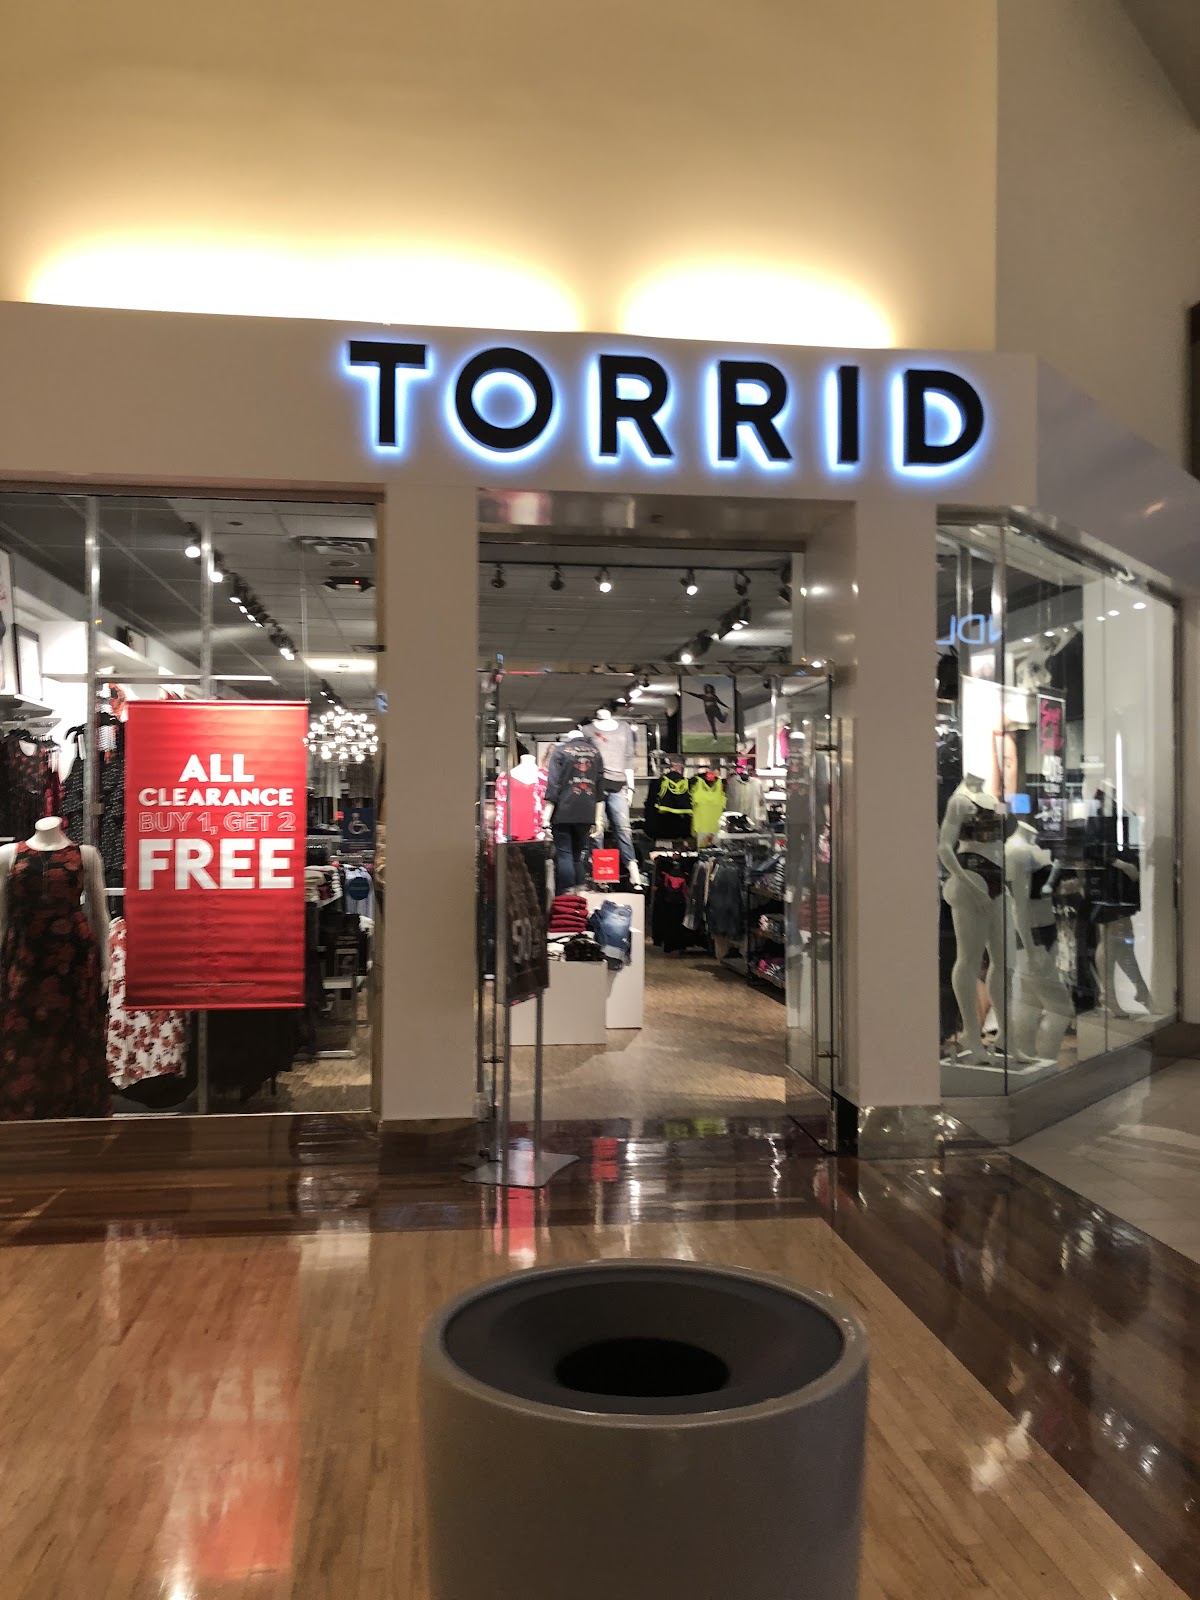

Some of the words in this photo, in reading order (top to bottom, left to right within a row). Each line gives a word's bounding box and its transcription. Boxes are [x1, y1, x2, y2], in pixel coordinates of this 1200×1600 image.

[349, 340, 984, 467] TORRID
[178, 753, 255, 783] ALL
[138, 787, 294, 807] CLEARANCE
[138, 811, 193, 832] BUY
[197, 811, 218, 835] 1,
[223, 811, 273, 832] GET
[277, 811, 297, 832] 2
[138, 838, 295, 891] FREE
